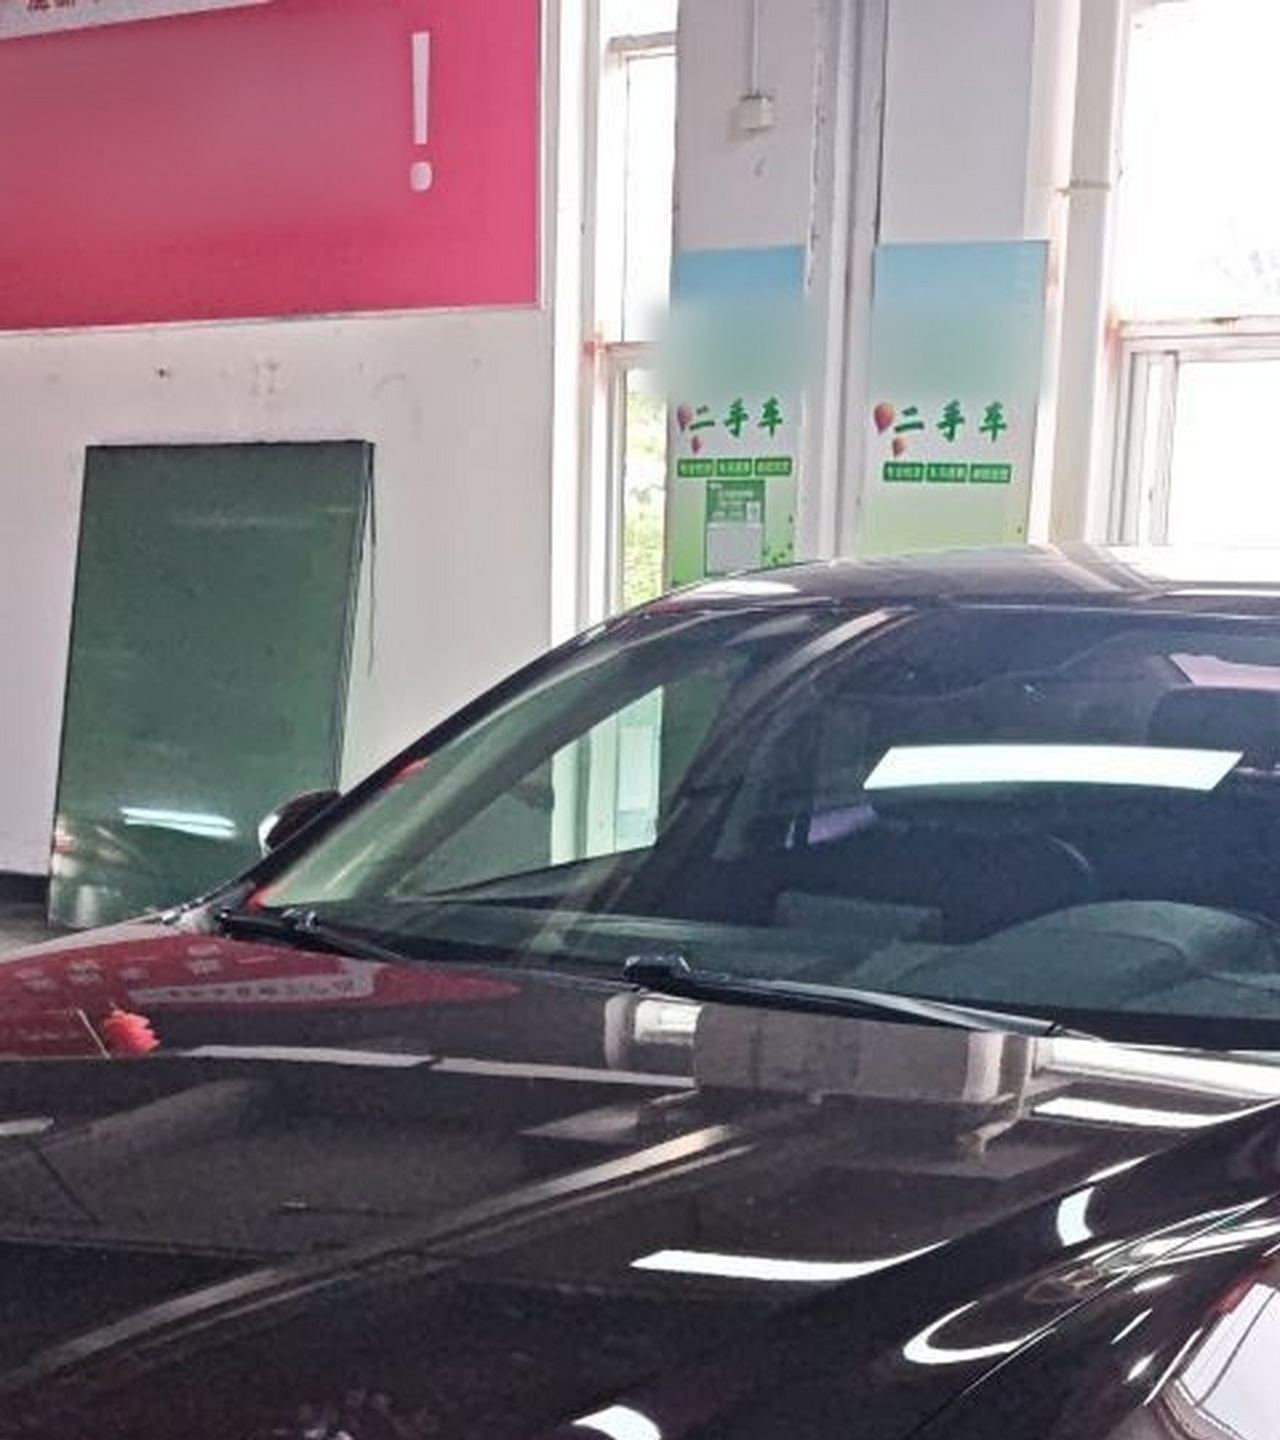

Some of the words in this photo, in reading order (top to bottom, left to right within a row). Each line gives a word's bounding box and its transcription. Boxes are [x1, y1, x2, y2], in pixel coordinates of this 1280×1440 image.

[689, 397, 783, 439] 二手车
[894, 399, 1008, 442] 二手车
